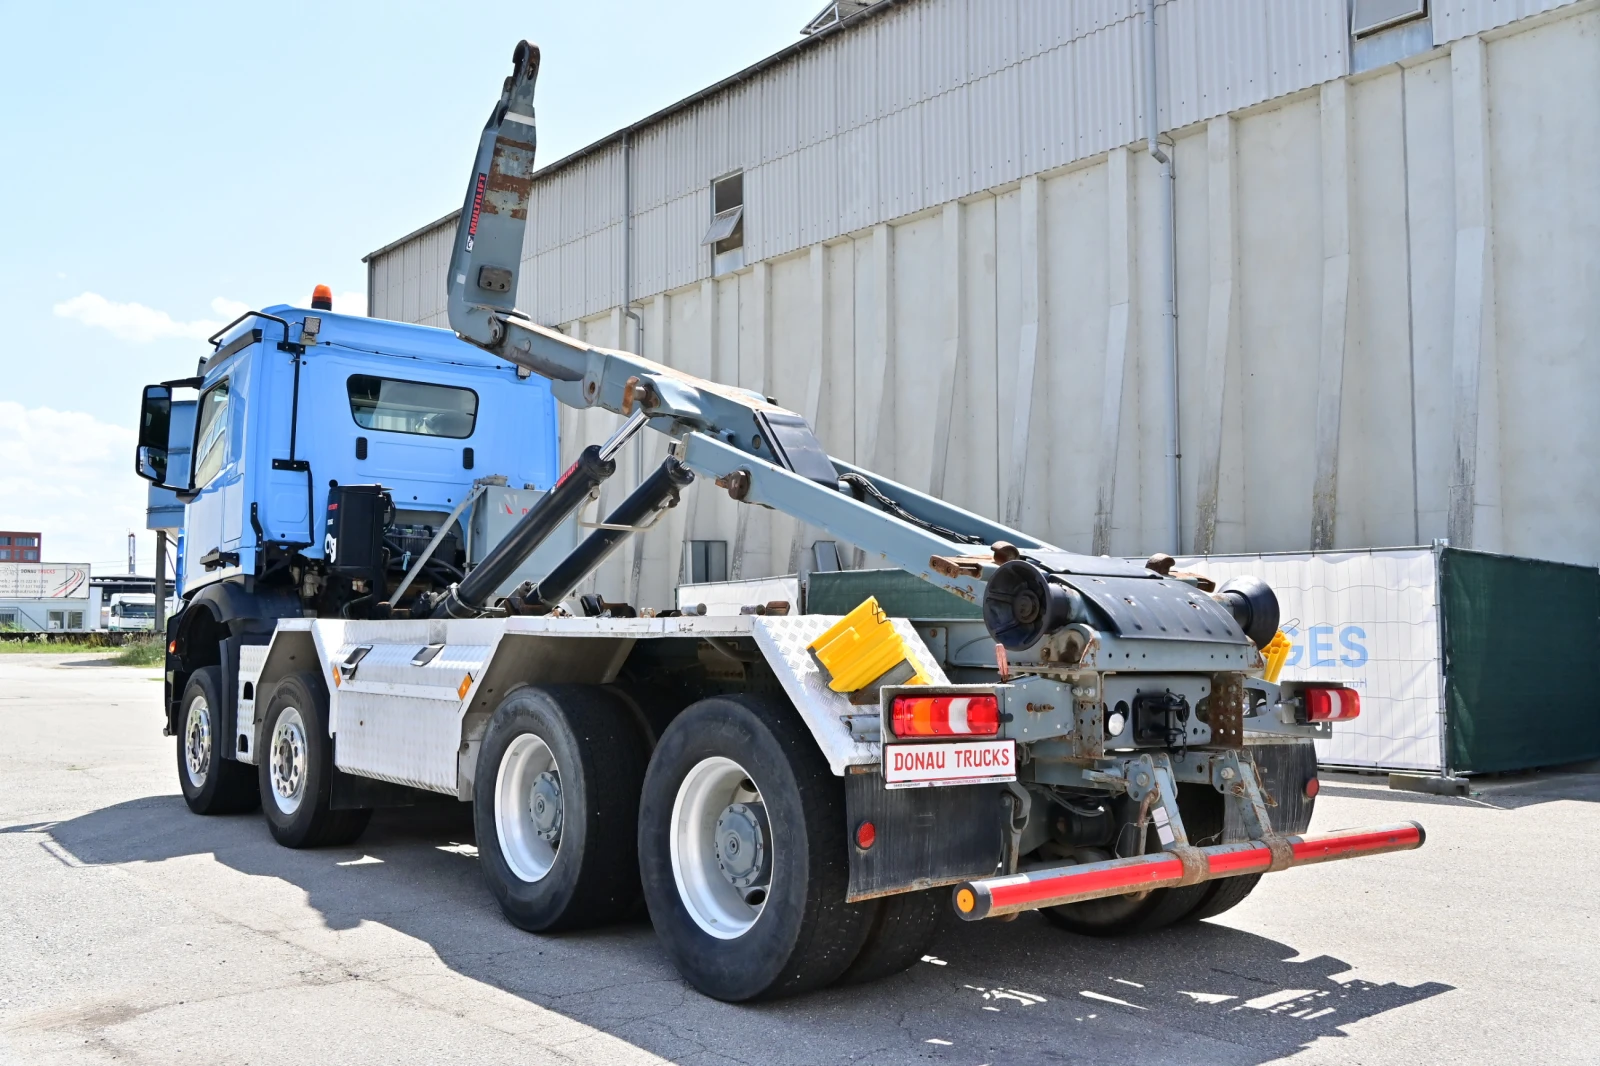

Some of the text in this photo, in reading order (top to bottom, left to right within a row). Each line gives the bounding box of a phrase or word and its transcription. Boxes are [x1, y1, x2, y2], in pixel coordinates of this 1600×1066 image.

[469, 174, 487, 235] MULTILIFT
[894, 748, 1010, 771] DONAU TRUCKS
